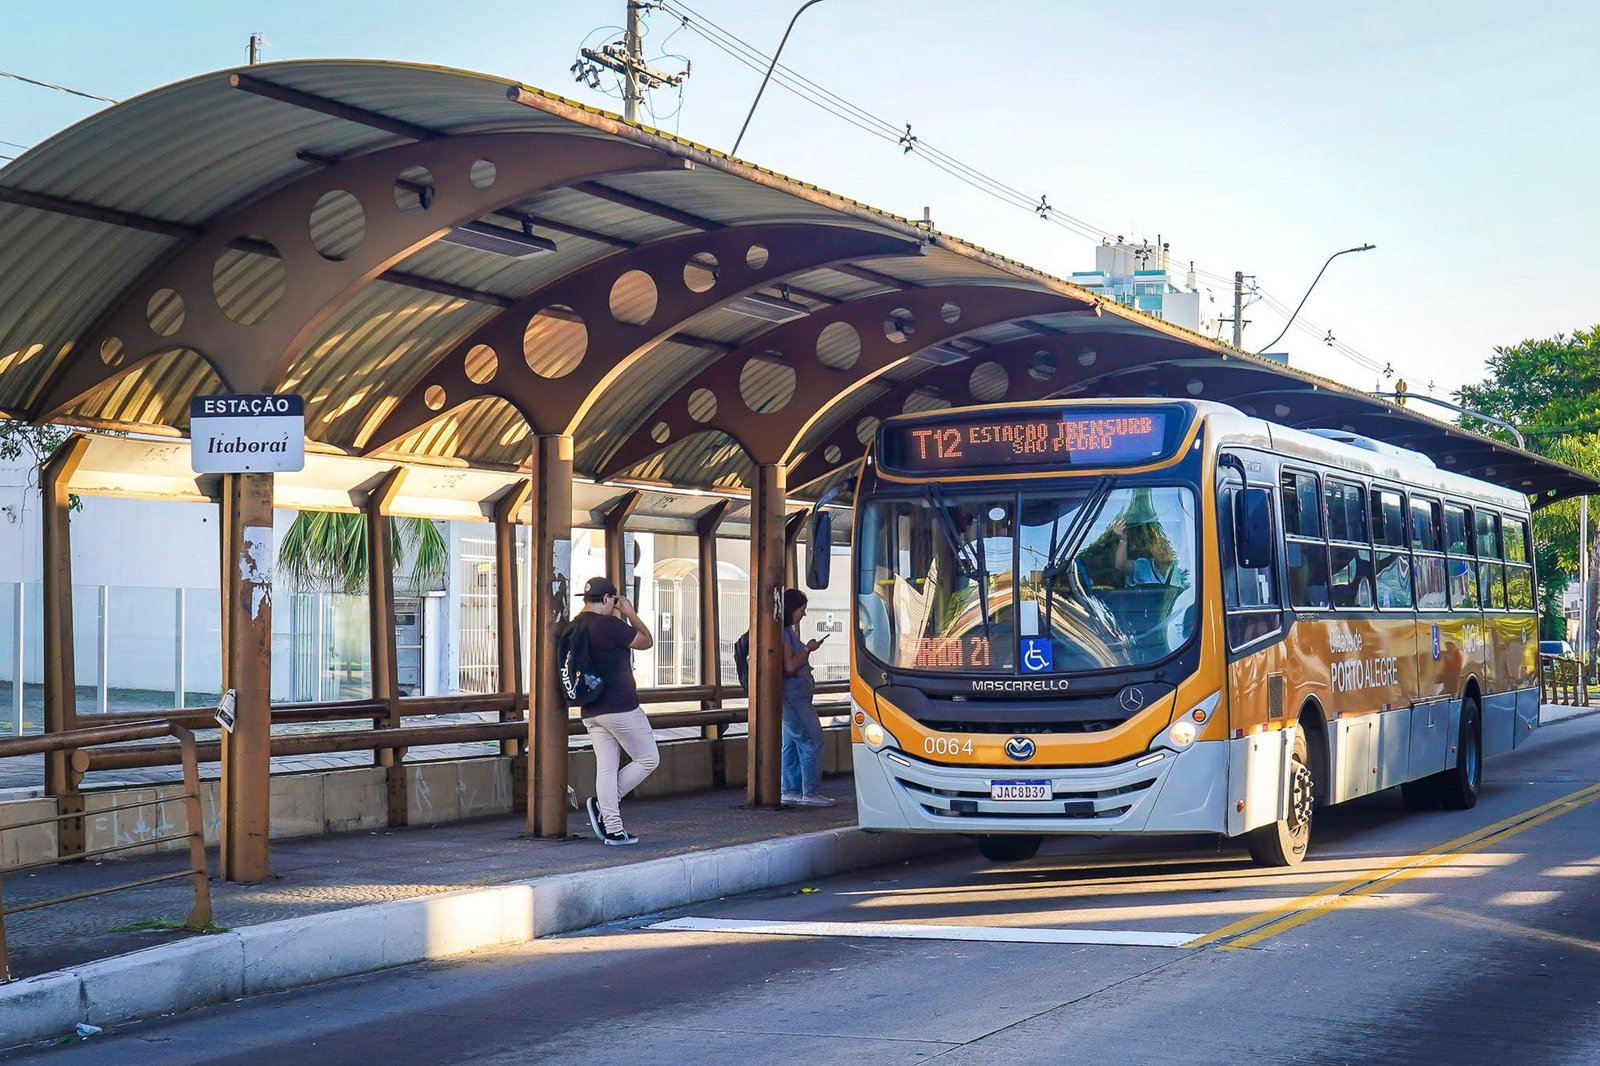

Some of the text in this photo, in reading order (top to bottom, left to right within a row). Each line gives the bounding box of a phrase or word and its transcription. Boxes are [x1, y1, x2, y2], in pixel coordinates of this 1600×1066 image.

[204, 397, 289, 415] ESTAÇÃO
[207, 436, 289, 454] Itaboraí
[912, 428, 962, 459] T12
[971, 636, 989, 666] 21
[1331, 657, 1398, 693] PORTO ALEGRE
[972, 680, 1068, 691] MASCARELLO
[924, 737, 973, 755] 0064
[997, 786, 1045, 798] JAC8D39
